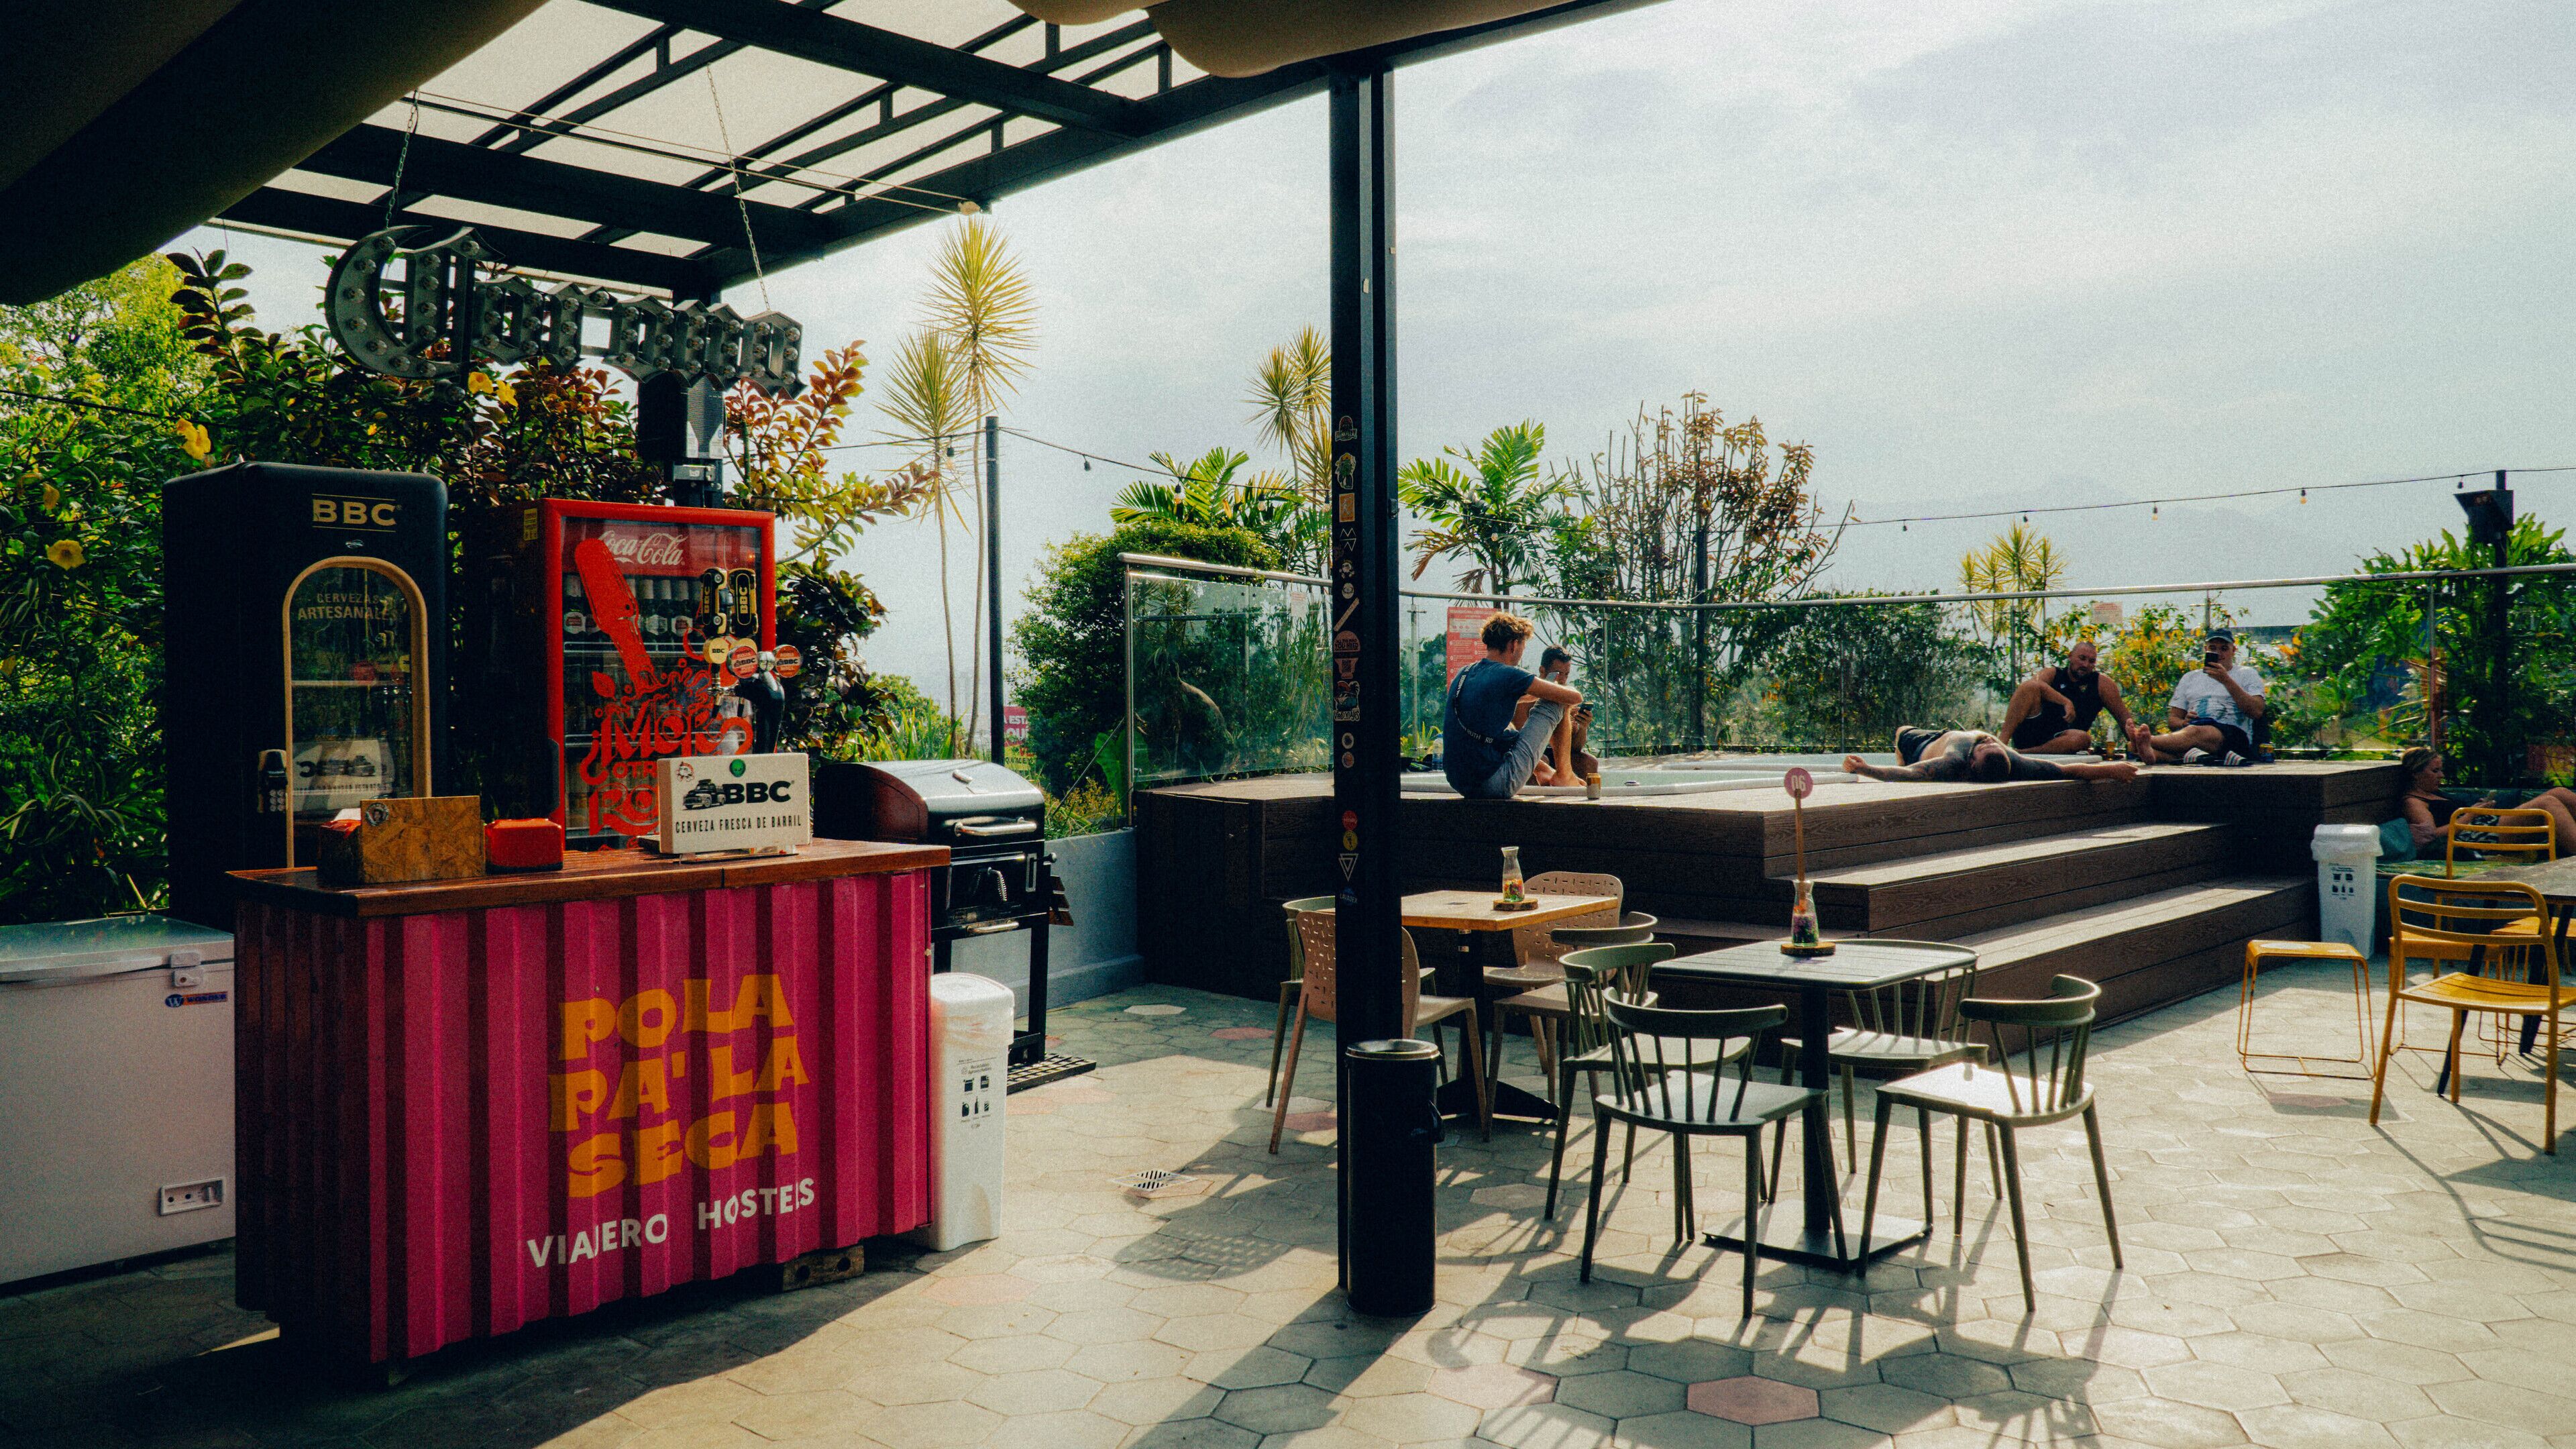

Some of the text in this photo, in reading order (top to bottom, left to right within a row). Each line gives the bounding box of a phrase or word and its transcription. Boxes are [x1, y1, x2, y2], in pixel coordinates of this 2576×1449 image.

[312, 498, 397, 527] BBC
[740, 586, 749, 614] BBC
[1009, 715, 1028, 724] EST
[722, 781, 794, 804] BBC
[1791, 775, 1806, 791] 06
[676, 814, 802, 833] CERVEZA FRESCA DE BARRIL
[558, 974, 794, 1061] POLA
[568, 1102, 798, 1198] SECA
[527, 1214, 668, 1269] VIAJERO
